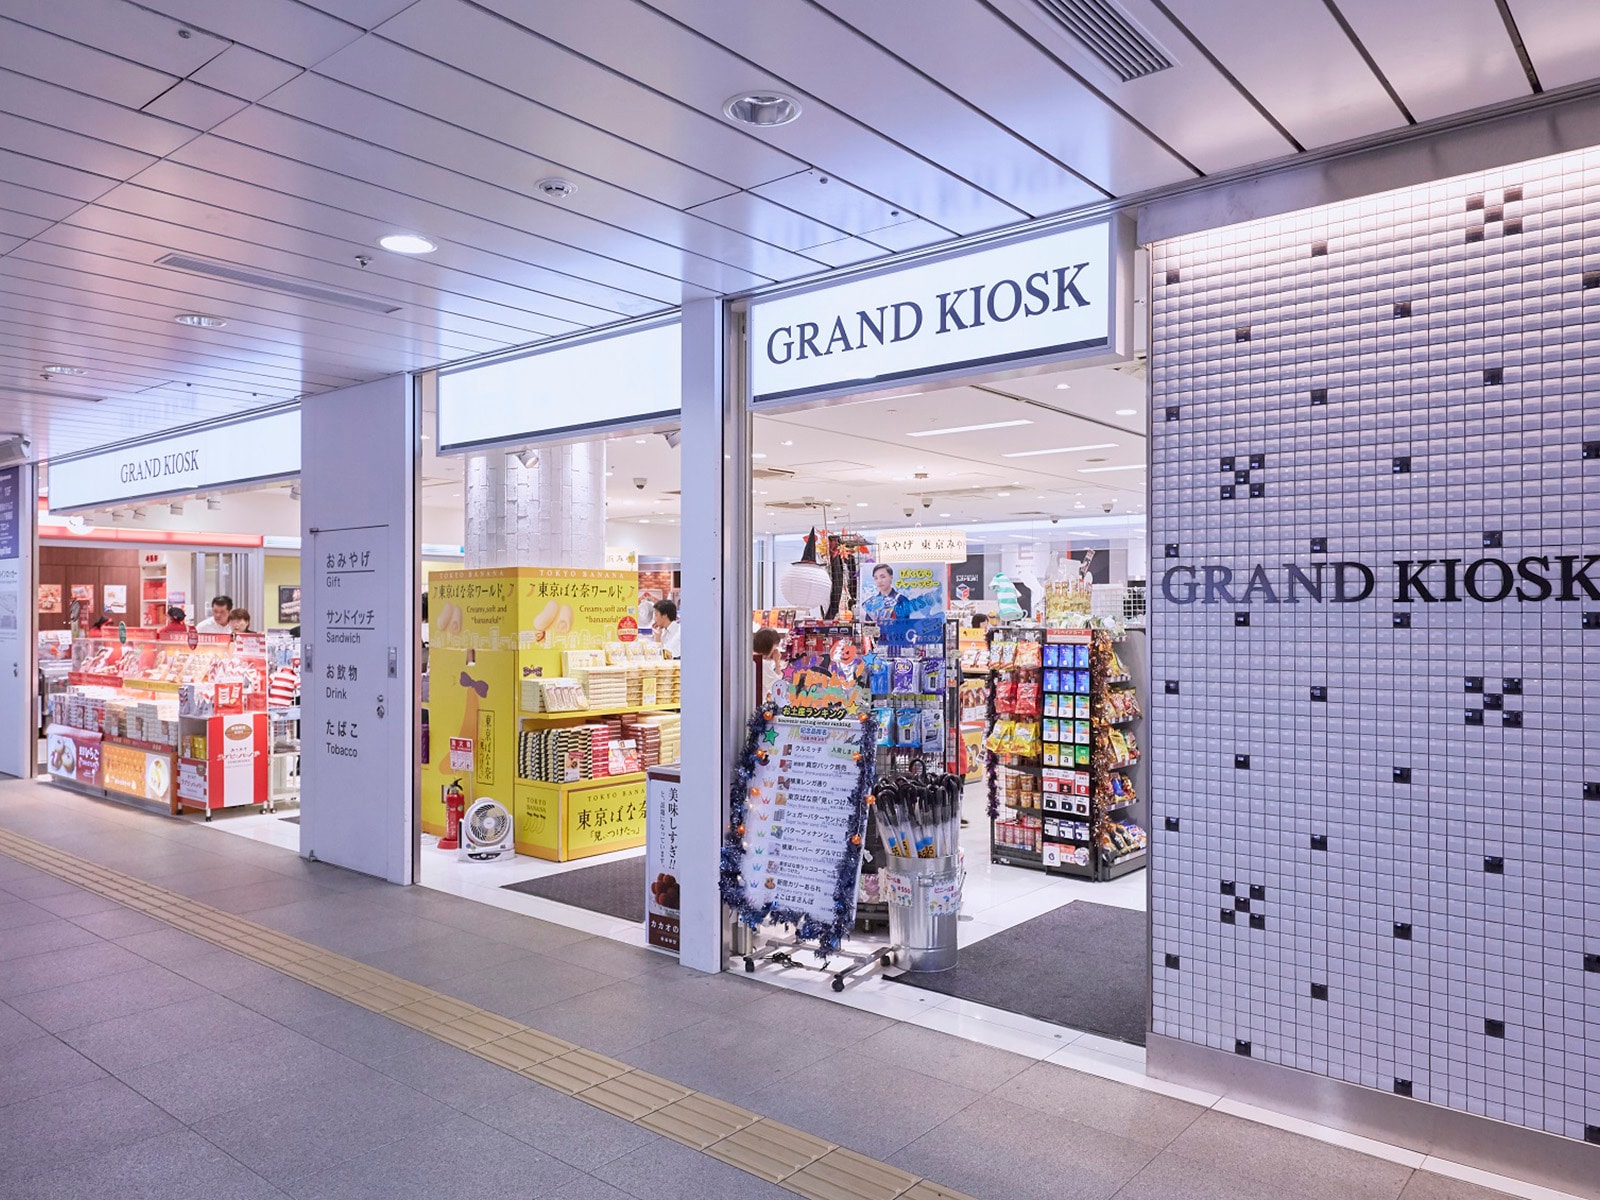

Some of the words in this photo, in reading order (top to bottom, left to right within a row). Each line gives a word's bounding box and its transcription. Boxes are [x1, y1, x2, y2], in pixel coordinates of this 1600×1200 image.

[767, 301, 923, 364] GRAND
[935, 263, 1090, 334] KIOSK
[120, 457, 160, 484] GRAND
[164, 449, 199, 476] KIOSK
[326, 550, 371, 569] おみやげ
[326, 576, 341, 588] Gift
[468, 570, 505, 579] BANANA
[540, 570, 576, 578] TOKYO
[583, 570, 625, 579] BANANA
[1161, 561, 1375, 604] GRAND
[1392, 554, 1600, 603] KIOSK
[439, 583, 503, 599] 東京ばな奈ワールド
[539, 582, 622, 599] 東京ばな奈ワールド
[326, 609, 375, 625] サンドイッチ
[326, 631, 362, 644] Sandwich
[326, 664, 358, 681] お飲物
[326, 687, 348, 700] Drink
[782, 706, 846, 720] お土産ランキング
[326, 719, 359, 738] たばこ
[326, 742, 358, 758] Tobacco
[526, 797, 547, 806] TOKYO
[587, 791, 617, 803] TOKYO
[526, 804, 547, 813] BANANA
